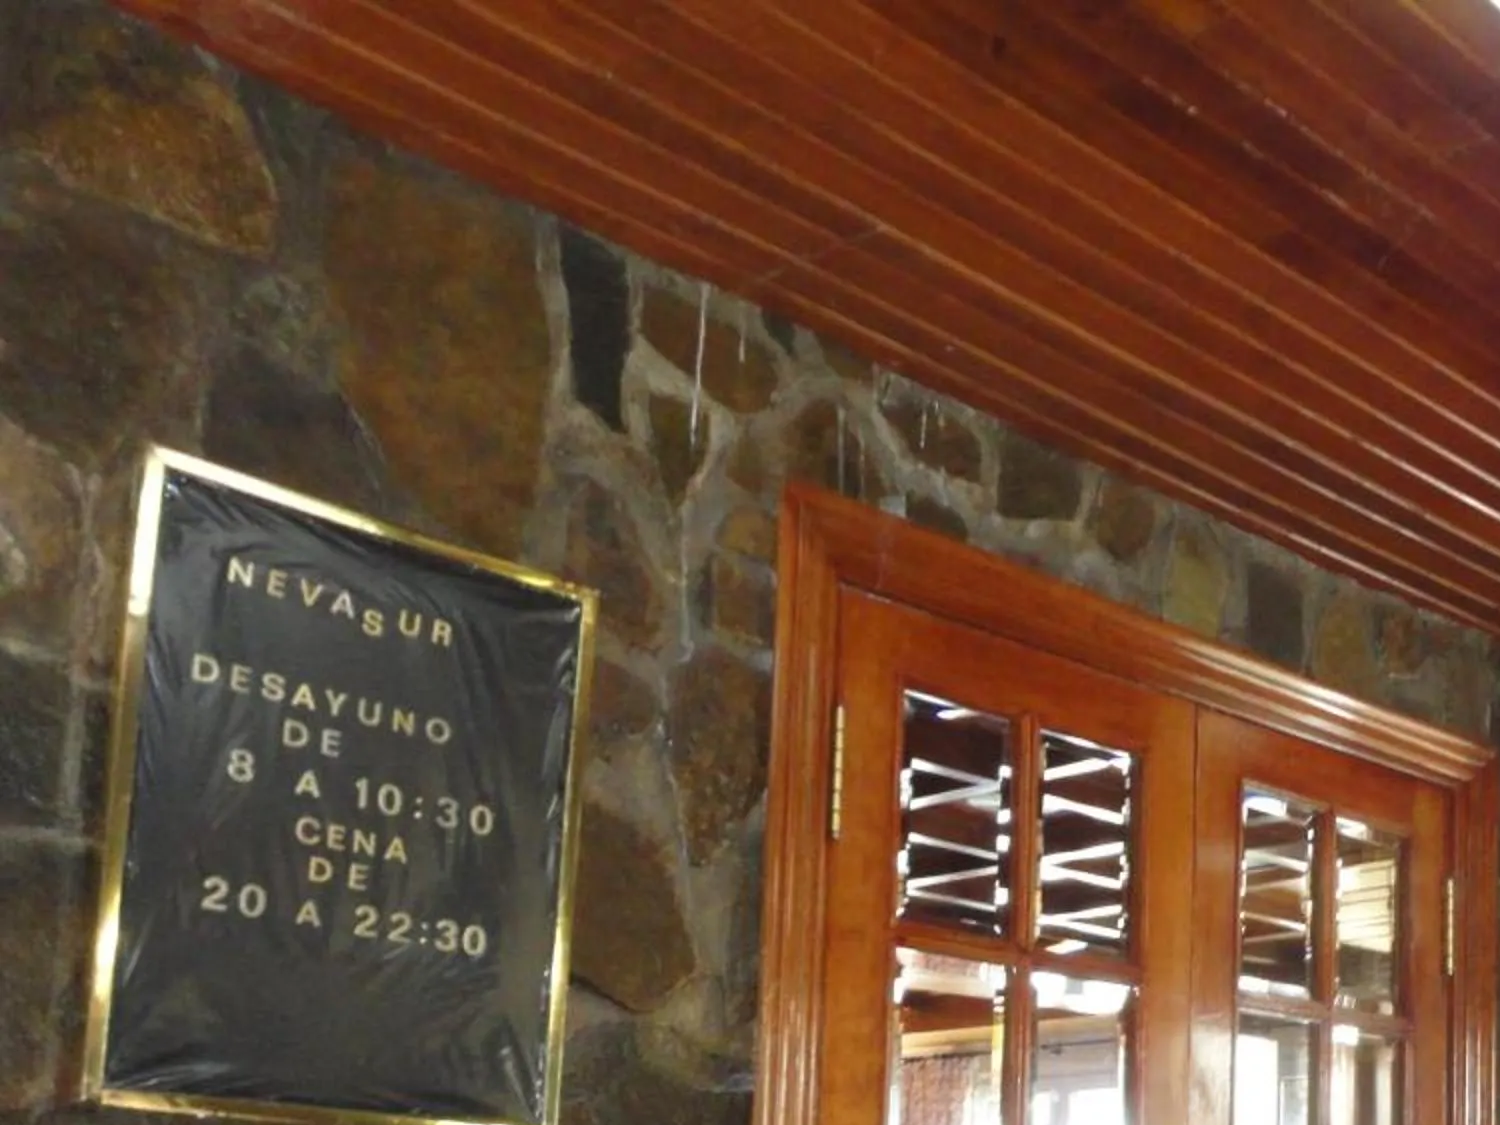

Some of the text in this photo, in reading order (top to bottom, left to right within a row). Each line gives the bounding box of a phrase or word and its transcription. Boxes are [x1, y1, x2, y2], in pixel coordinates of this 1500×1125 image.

[226, 556, 453, 647] NEVASUR
[191, 653, 452, 745] DESAYUNO
[282, 718, 342, 758] DE
[227, 749, 495, 836] 8 A 10:30
[294, 816, 408, 864] CENA
[308, 856, 370, 891] DE
[201, 875, 487, 956] 20 A 22:30
